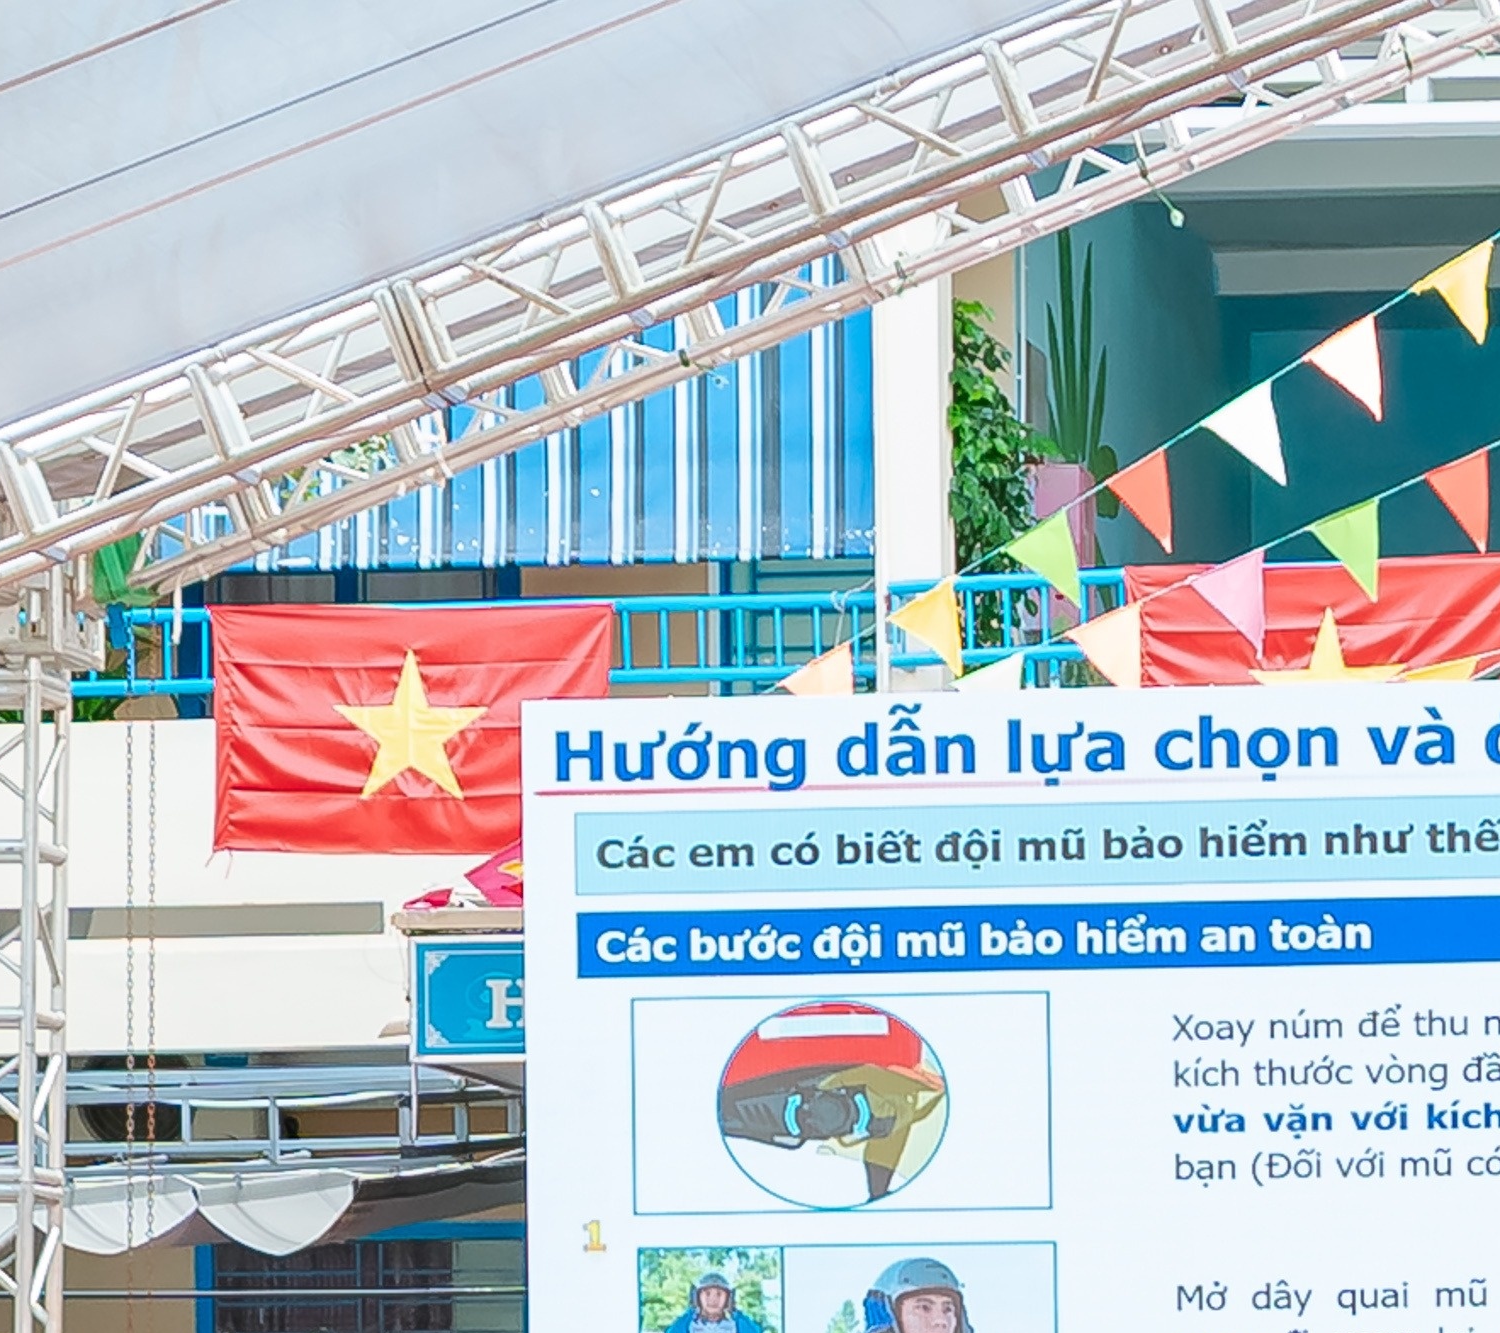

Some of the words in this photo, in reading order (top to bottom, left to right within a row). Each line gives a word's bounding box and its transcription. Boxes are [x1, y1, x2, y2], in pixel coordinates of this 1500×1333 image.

[555, 720, 807, 794] Hướng
[836, 702, 976, 779] dẫn
[1007, 718, 1126, 787] lựa
[1154, 714, 1339, 782] chọn
[1366, 706, 1456, 766] và
[596, 834, 675, 869] Các
[688, 843, 755, 868] em
[770, 831, 820, 866] có
[836, 829, 922, 866] biết
[935, 828, 1001, 870] đội
[1018, 827, 1086, 862] mũ
[1103, 825, 1183, 860] bảo
[1199, 818, 1307, 859] hiểm
[1324, 823, 1415, 856] như
[597, 927, 676, 962] Các
[691, 925, 800, 960] bước
[814, 924, 881, 965] đội
[898, 922, 965, 957] mũ
[981, 920, 1062, 955] bảo
[1077, 915, 1186, 954] hiểm
[1201, 926, 1255, 952] an
[1270, 915, 1371, 950] toàn
[1173, 1014, 1255, 1048] Xoay
[1269, 1008, 1343, 1039] núm
[1358, 1003, 1402, 1038] để
[1414, 1009, 1468, 1037] thu
[1174, 1057, 1239, 1087] kích
[1253, 1055, 1353, 1087] thước
[1365, 1054, 1448, 1092] vòng
[1173, 1103, 1246, 1134] vừa
[1263, 1103, 1333, 1140] vặn
[1350, 1100, 1408, 1131] với
[1175, 1153, 1236, 1188] bạn
[1336, 1148, 1384, 1178] với
[1400, 1148, 1452, 1177] mũ
[1177, 1280, 1228, 1311] Mở
[1251, 1279, 1312, 1317] dây
[1337, 1282, 1409, 1316] quai
[1436, 1278, 1487, 1308] mũ
